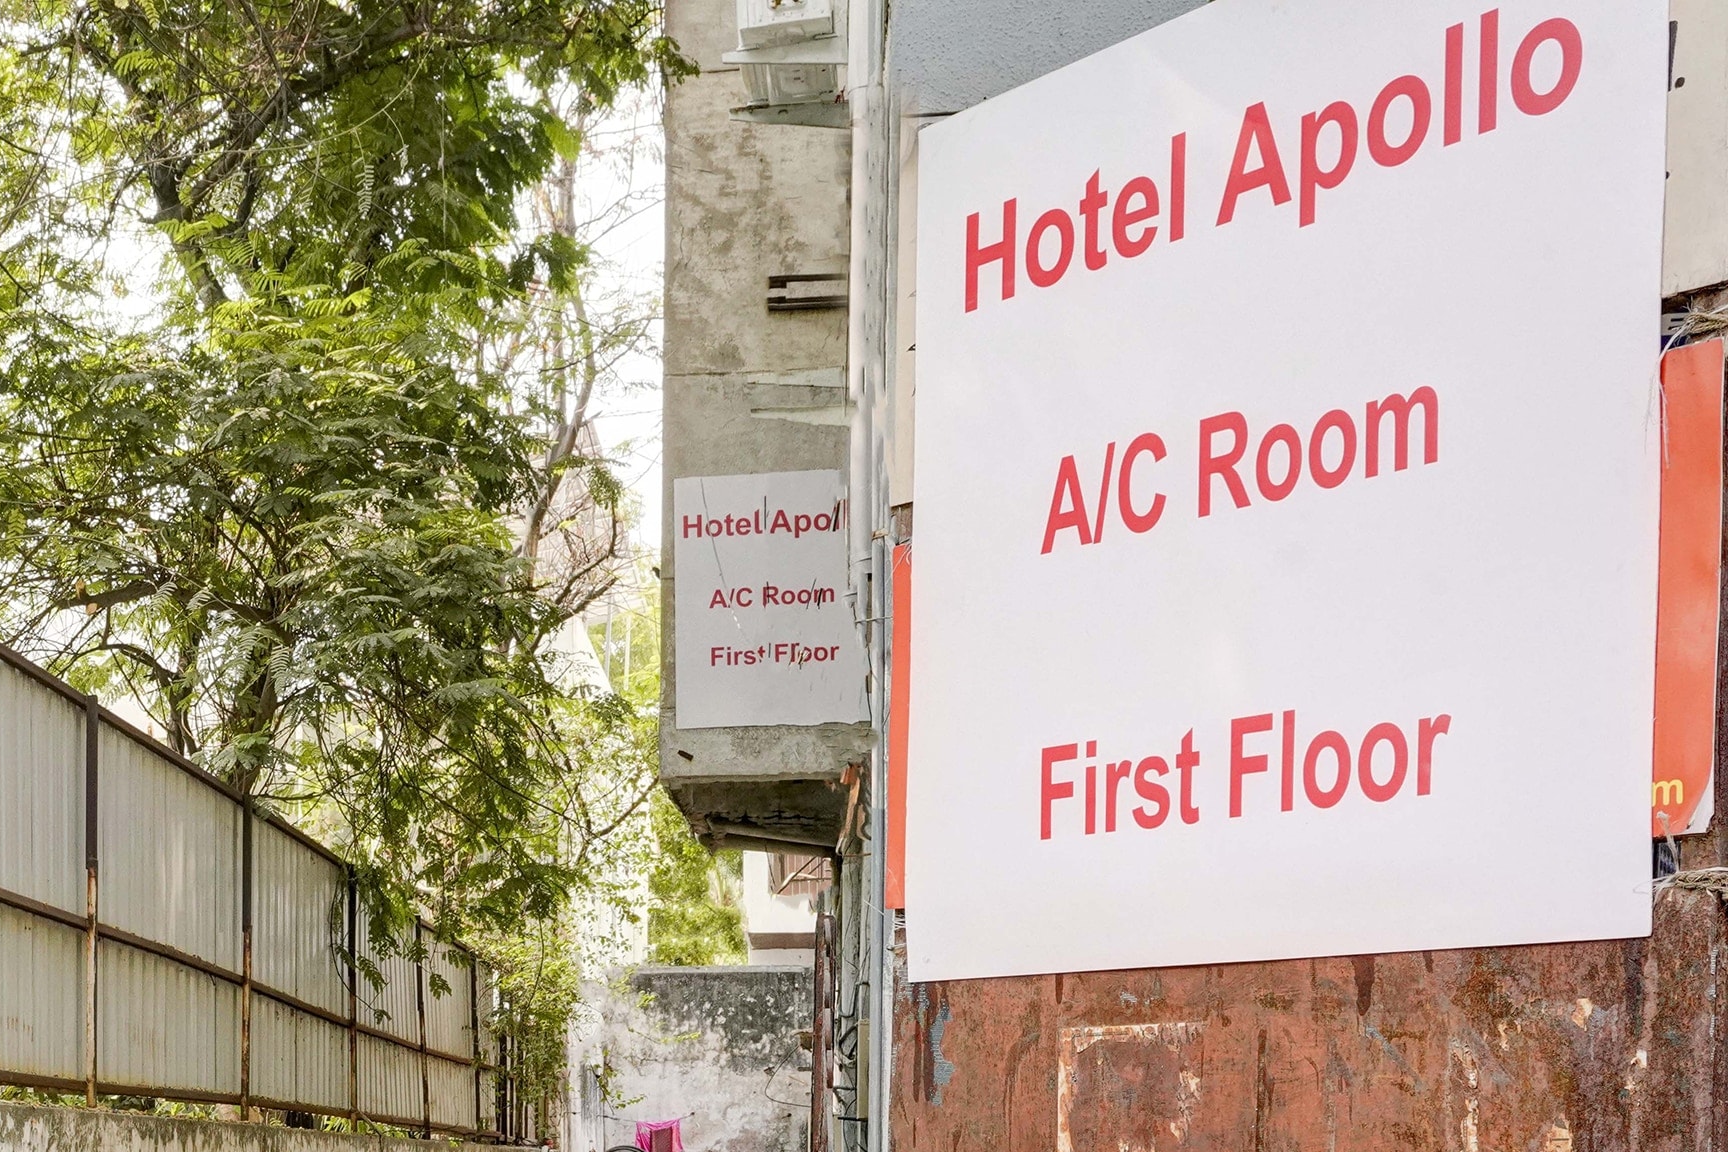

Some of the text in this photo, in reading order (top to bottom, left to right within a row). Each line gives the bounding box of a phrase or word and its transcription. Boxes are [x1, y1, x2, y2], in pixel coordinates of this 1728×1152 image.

[964, 8, 1583, 314] Hotel Apollo
[1040, 385, 1439, 555] A/C Room
[682, 510, 763, 539] Hotel
[709, 585, 835, 609] A/C Room
[710, 645, 766, 667] First
[1040, 709, 1452, 841] First Floor
